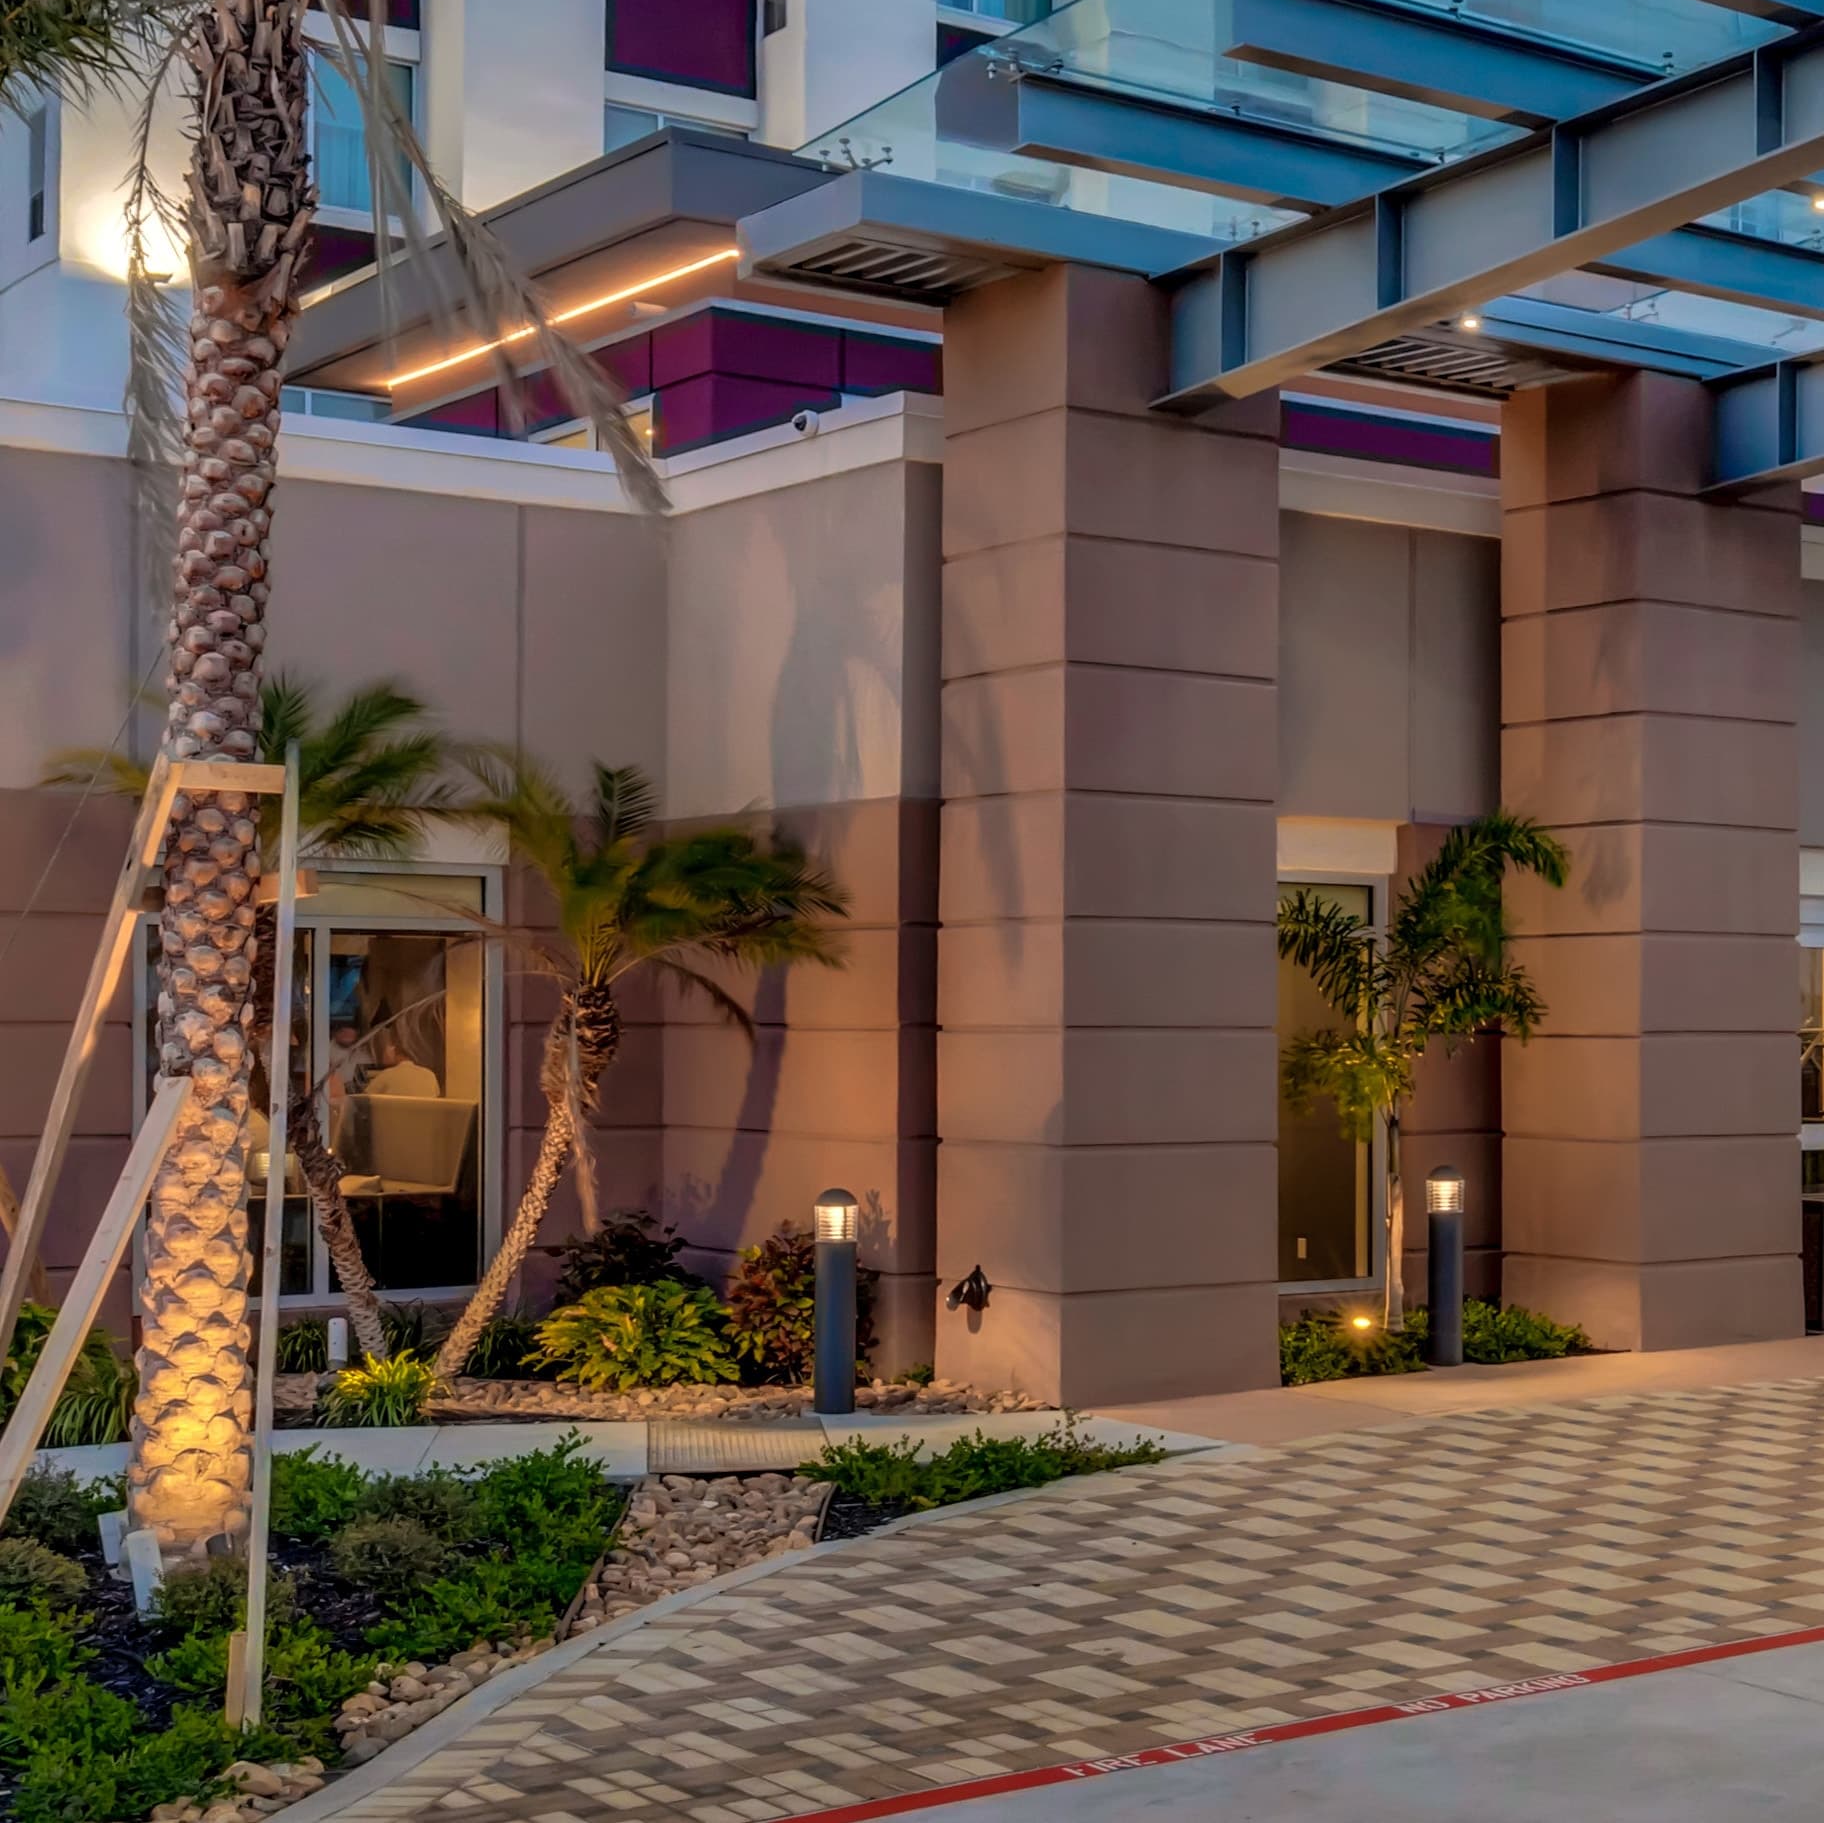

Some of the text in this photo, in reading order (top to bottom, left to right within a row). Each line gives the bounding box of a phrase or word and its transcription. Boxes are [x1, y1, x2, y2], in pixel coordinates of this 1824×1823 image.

[1394, 1674, 1591, 1713] NO PARKING
[1062, 1732, 1273, 1777] FIRE LANE
